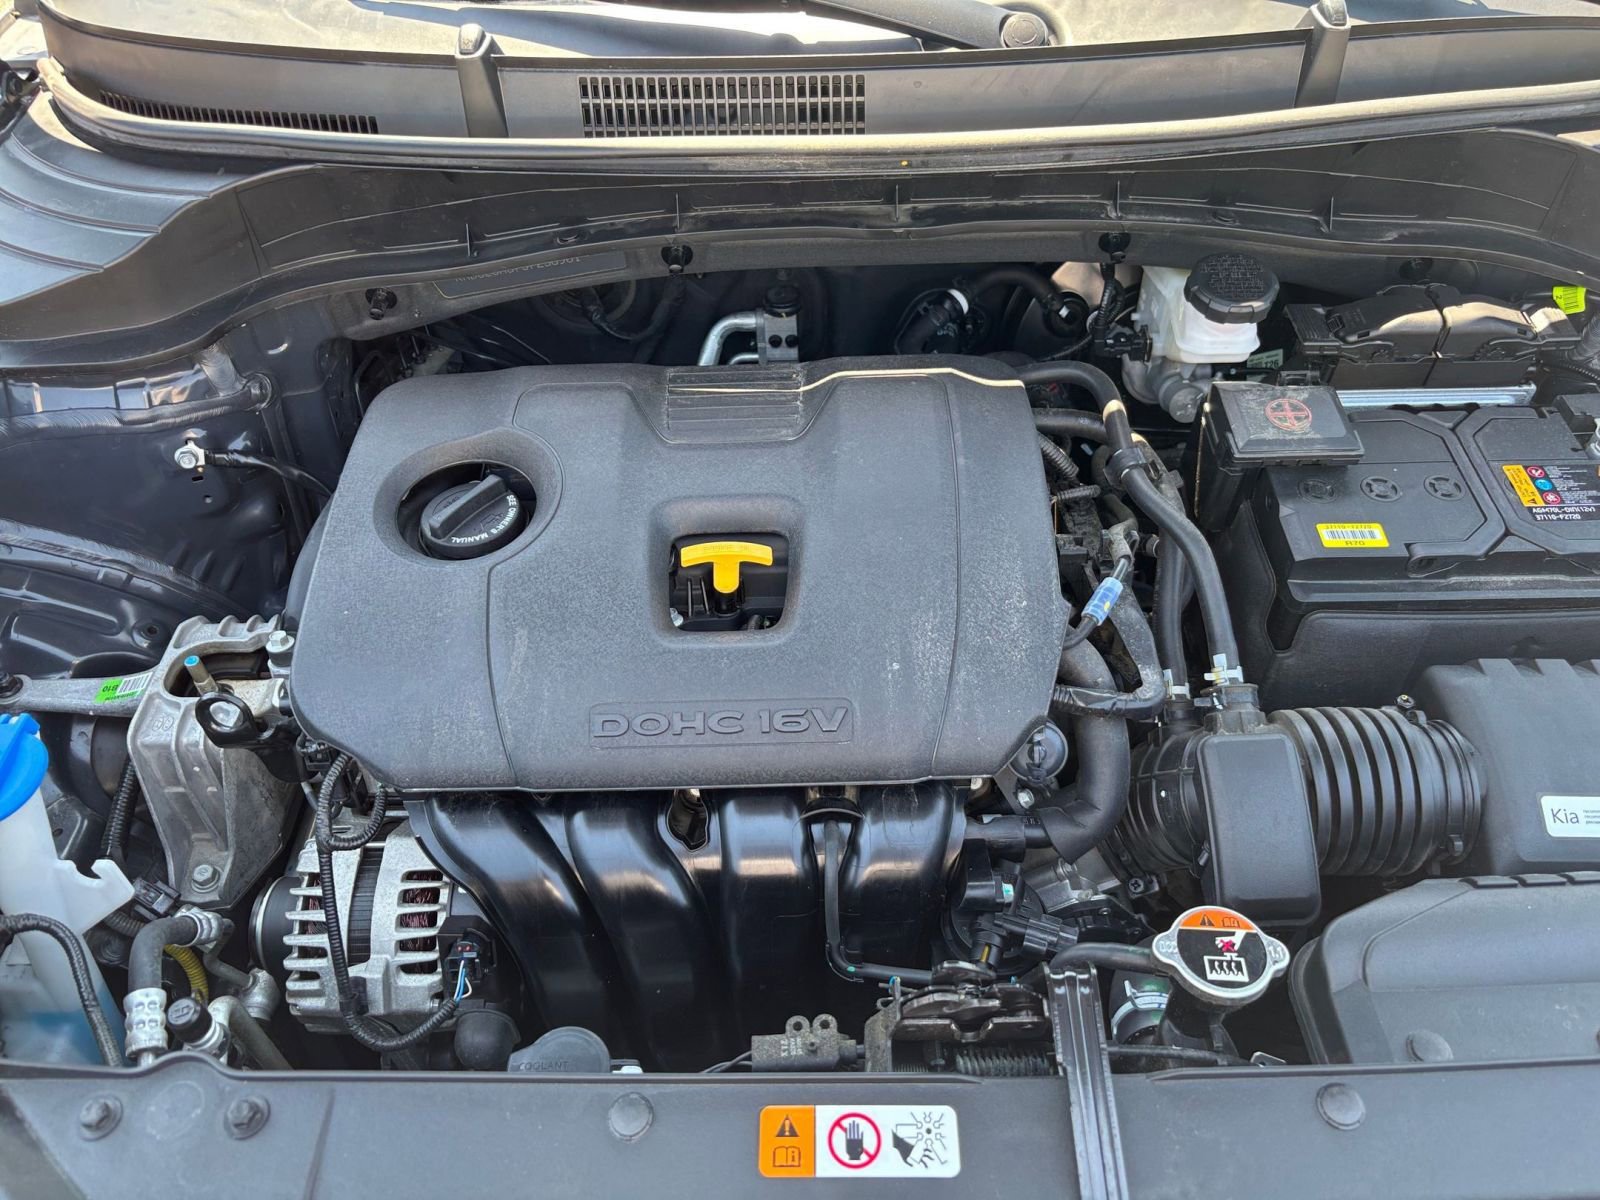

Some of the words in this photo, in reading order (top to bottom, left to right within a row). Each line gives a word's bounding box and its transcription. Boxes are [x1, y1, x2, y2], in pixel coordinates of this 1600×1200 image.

[451, 532, 489, 543] MANUAL
[592, 709, 744, 738] DOHC
[759, 707, 848, 734] 16V
[1551, 808, 1579, 824] Kia
[519, 1061, 568, 1073] COOLANT
